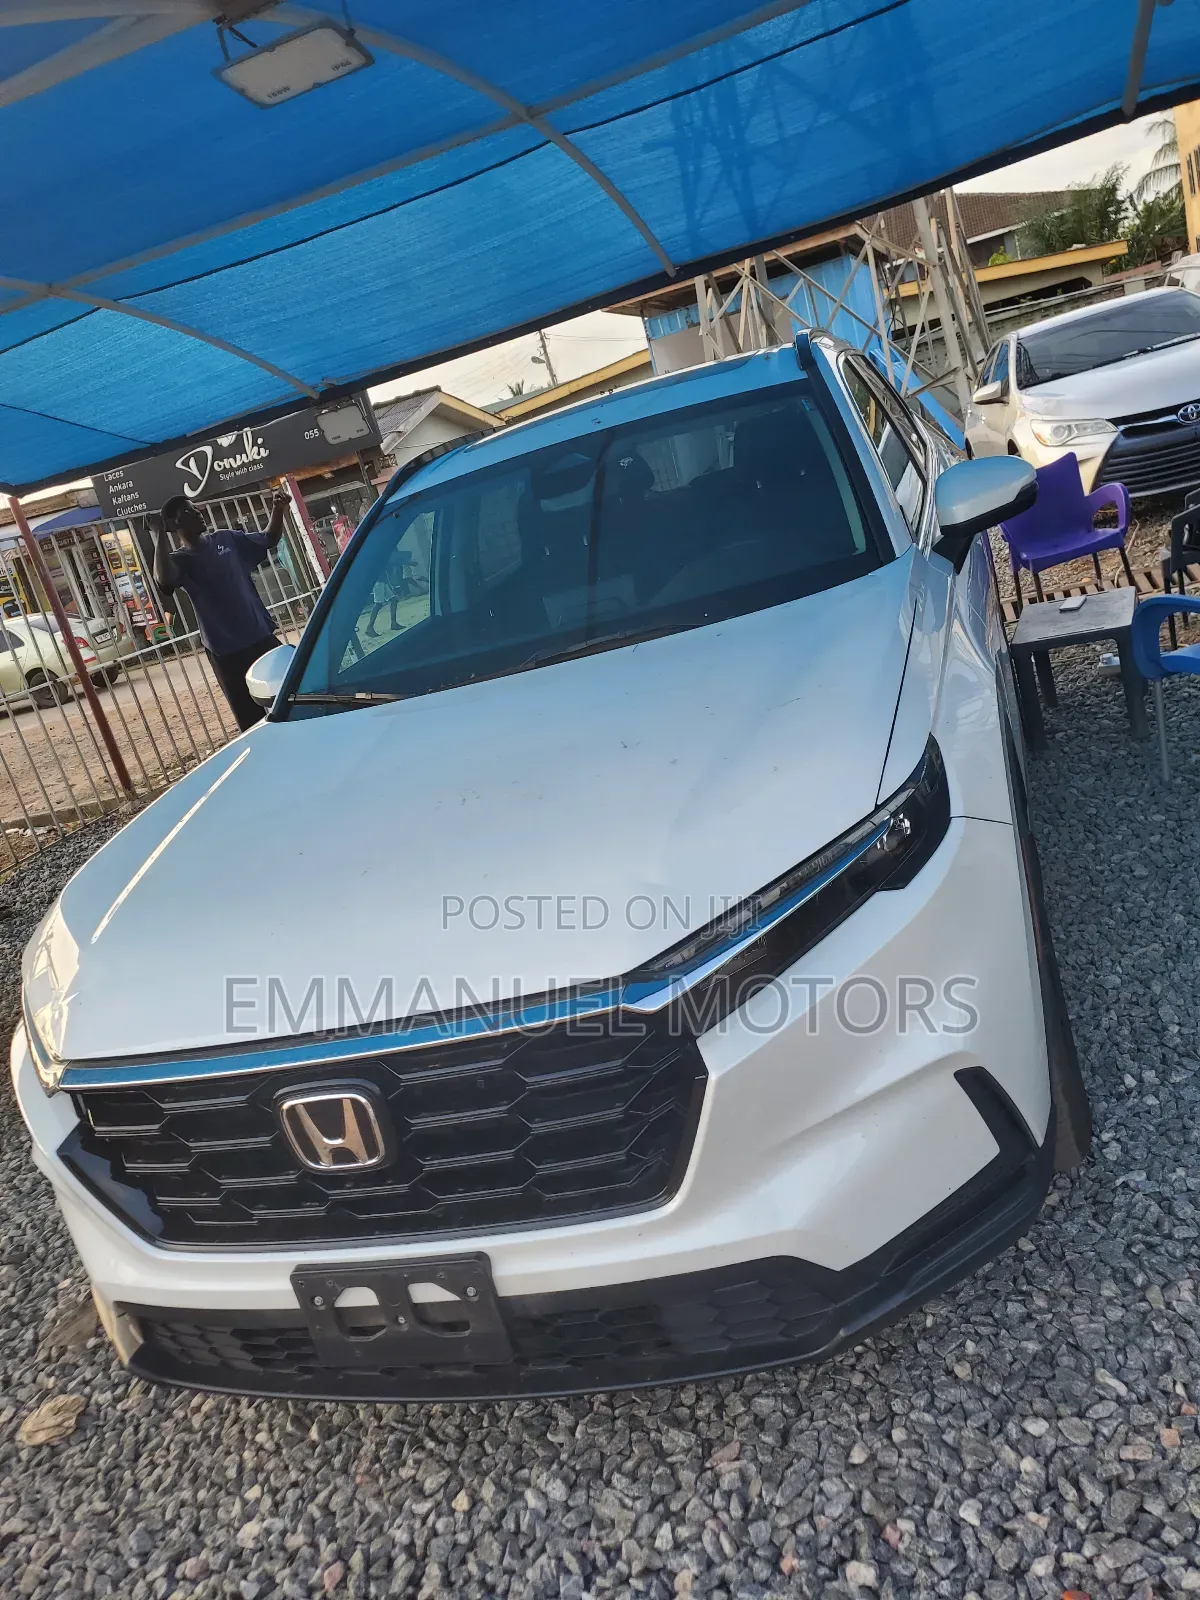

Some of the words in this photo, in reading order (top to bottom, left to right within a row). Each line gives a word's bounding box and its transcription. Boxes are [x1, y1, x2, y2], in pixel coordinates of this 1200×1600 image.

[304, 428, 320, 440] 055
[175, 427, 270, 498] Donuki
[103, 470, 124, 482] Laces
[219, 472, 235, 481] Style
[235, 467, 248, 476] with
[249, 462, 264, 472] class
[109, 480, 134, 494] Ankara
[112, 491, 140, 505] Kaftans
[116, 502, 147, 517] Clutches
